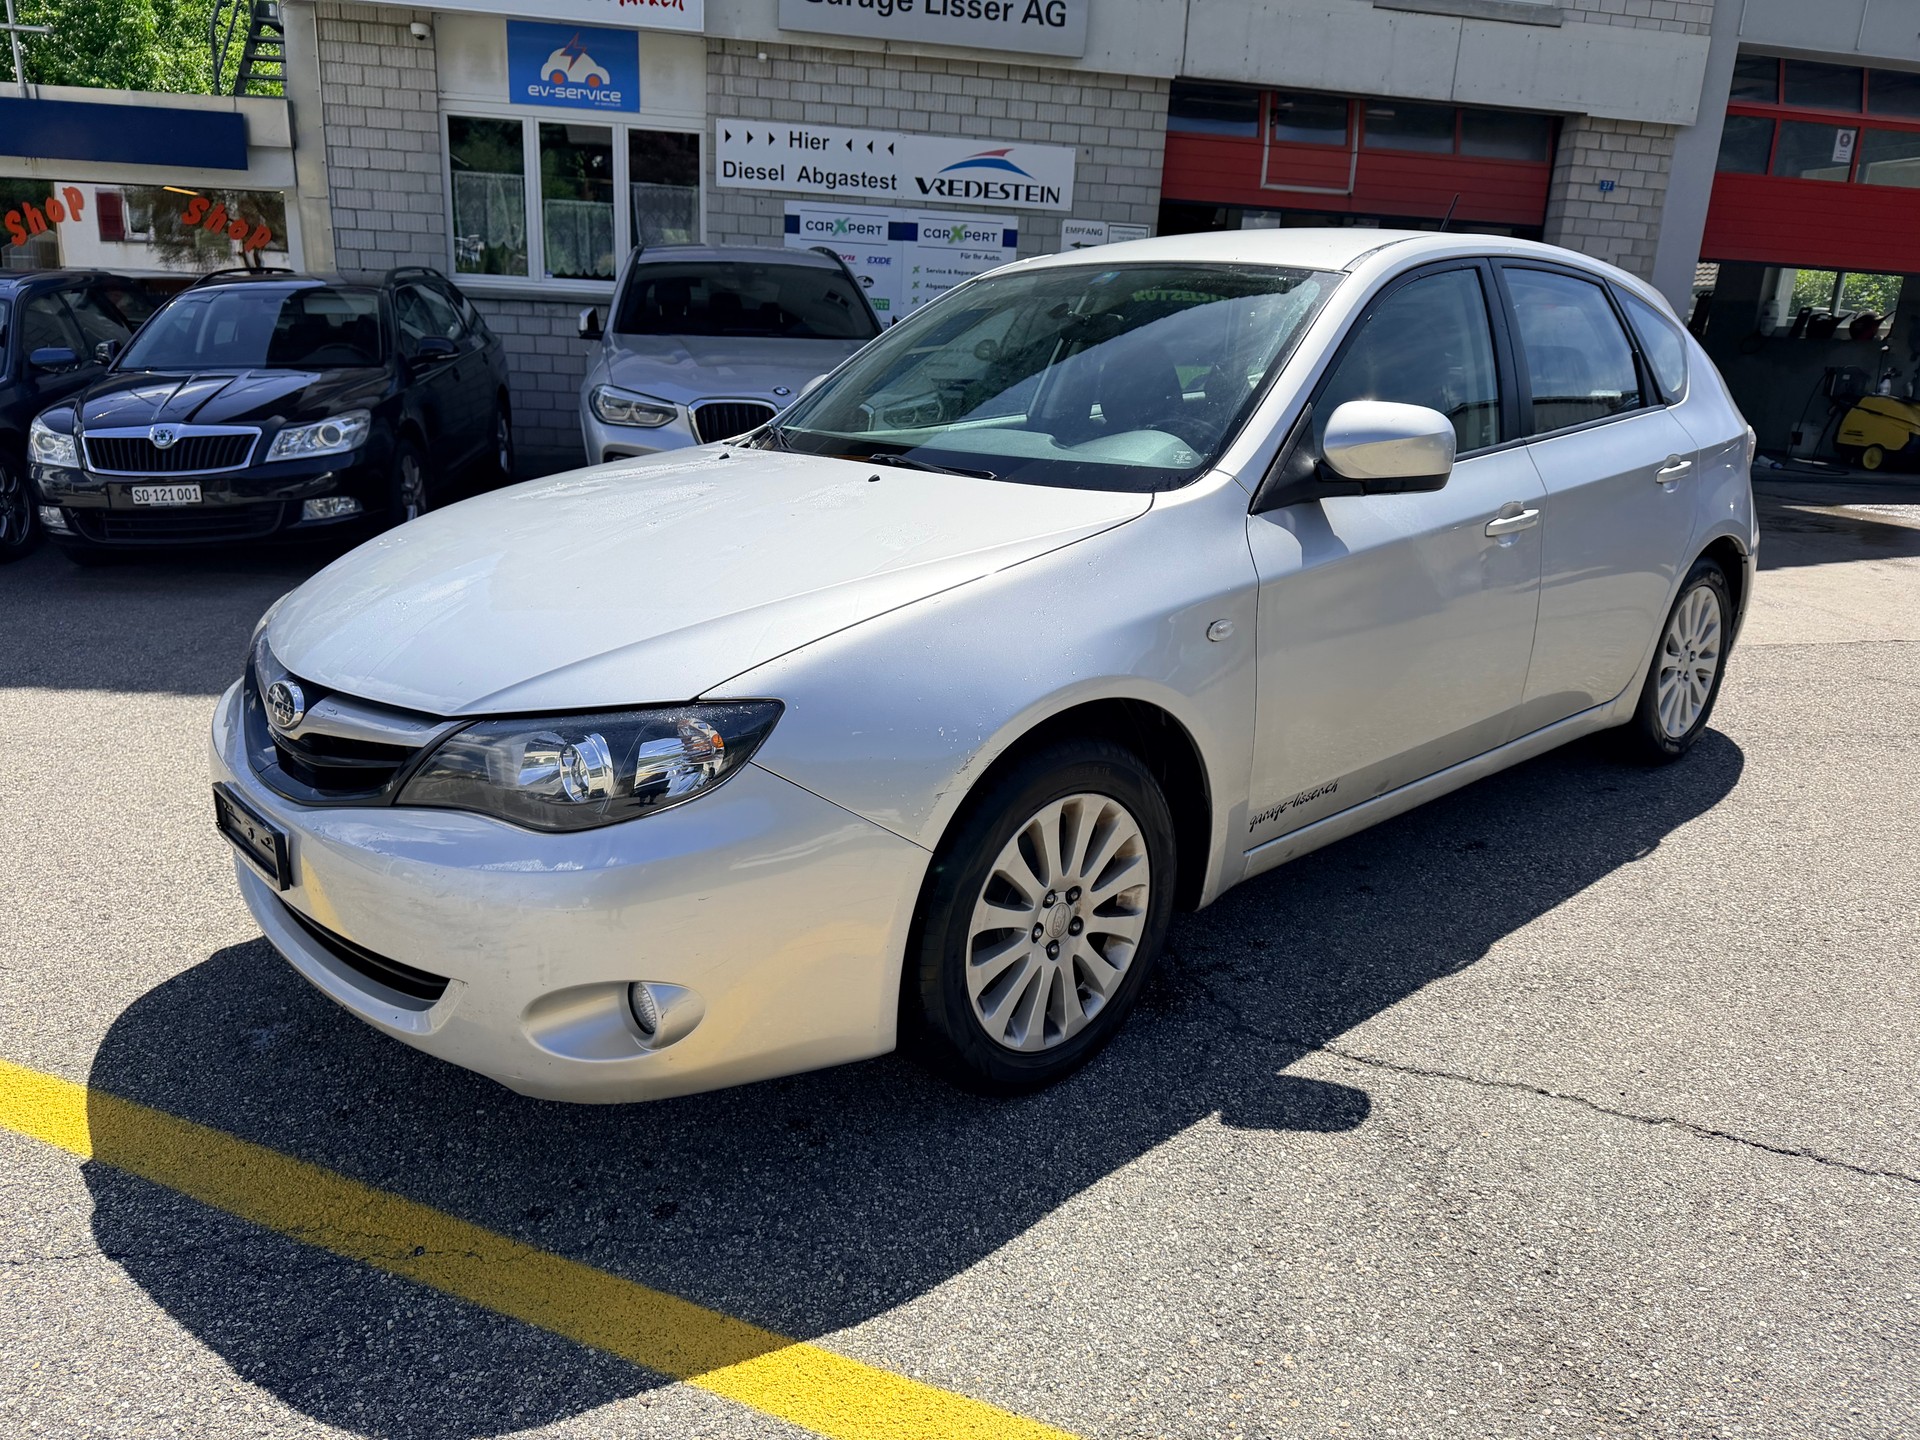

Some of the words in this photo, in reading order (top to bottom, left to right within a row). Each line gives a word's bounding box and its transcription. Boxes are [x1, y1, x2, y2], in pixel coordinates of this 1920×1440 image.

[1021, 0, 1066, 27] AG
[527, 84, 622, 103] ev-service
[789, 130, 830, 151] Hier
[723, 160, 785, 182] Diesel
[797, 165, 898, 191] Abgastest
[915, 176, 1061, 204] VREDESTEIN
[4, 186, 85, 247] Shop
[181, 196, 272, 253] Shop
[1065, 226, 1103, 236] EMPFANG
[866, 256, 892, 265] EXIDE
[960, 252, 972, 260] Für
[926, 267, 946, 275] Service
